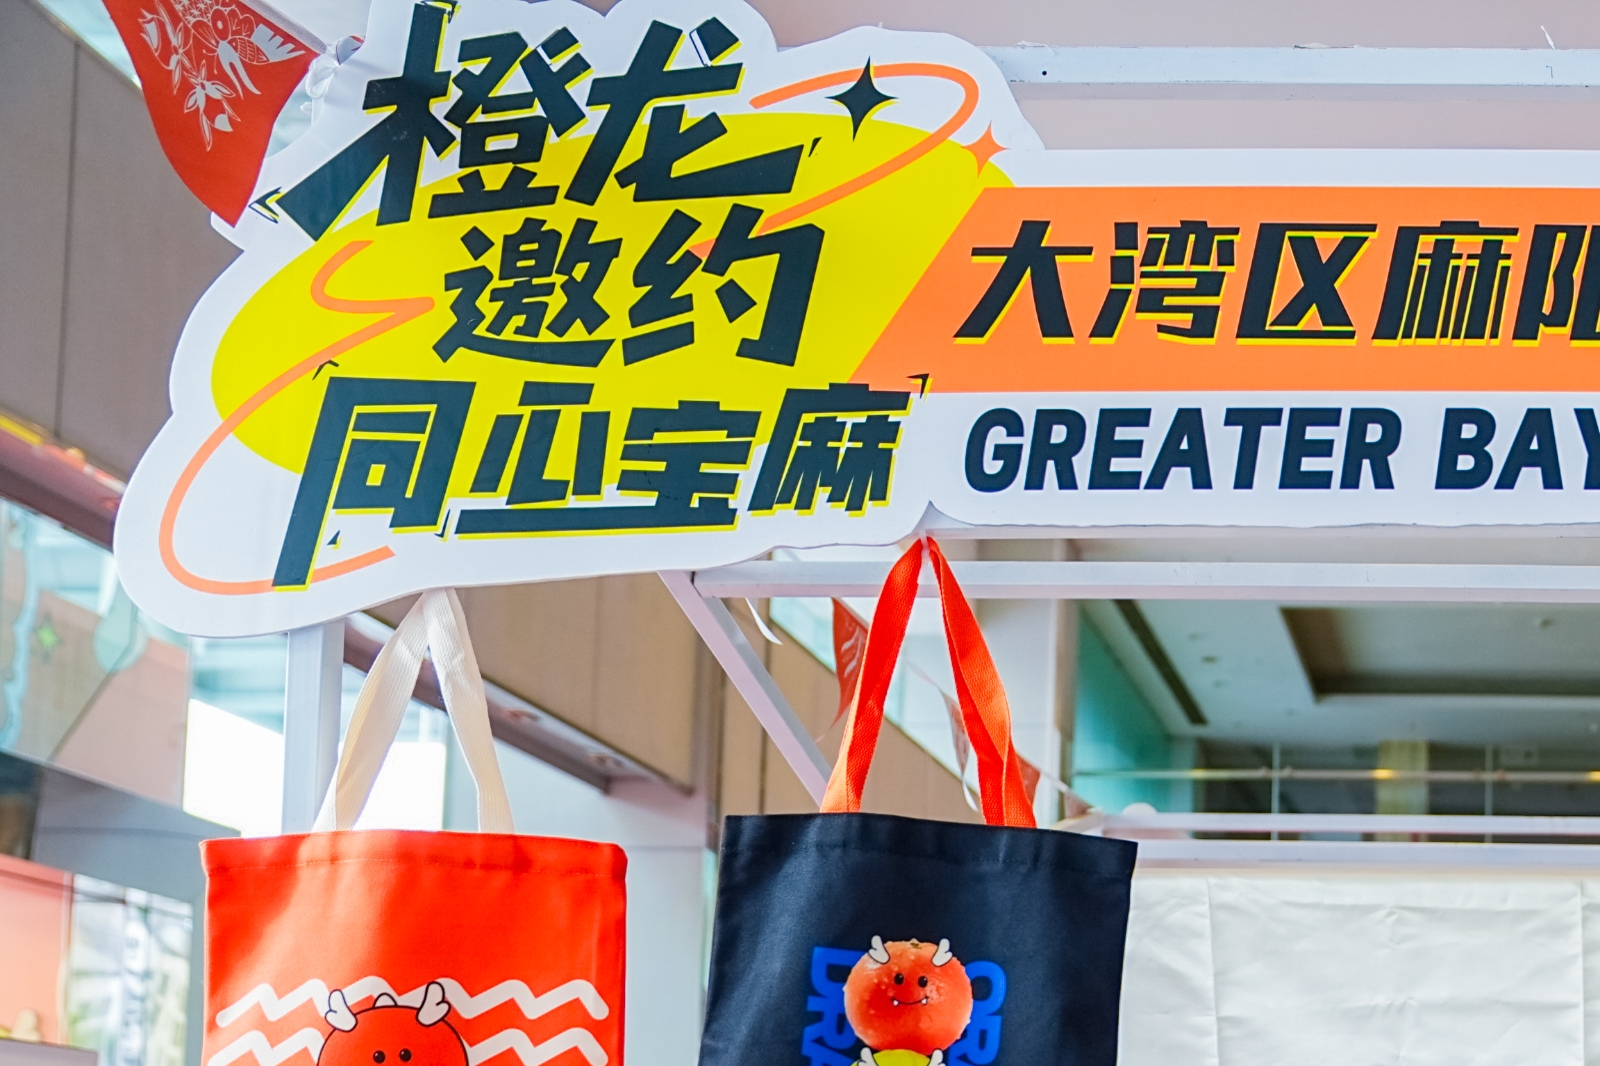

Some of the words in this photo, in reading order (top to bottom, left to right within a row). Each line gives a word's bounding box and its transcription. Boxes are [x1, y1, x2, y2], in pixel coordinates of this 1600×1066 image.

[272, 0, 808, 240] 橙龙
[433, 204, 825, 368] 邀约
[272, 376, 914, 591] 同心宝麻
[964, 406, 1402, 494] GREATER
